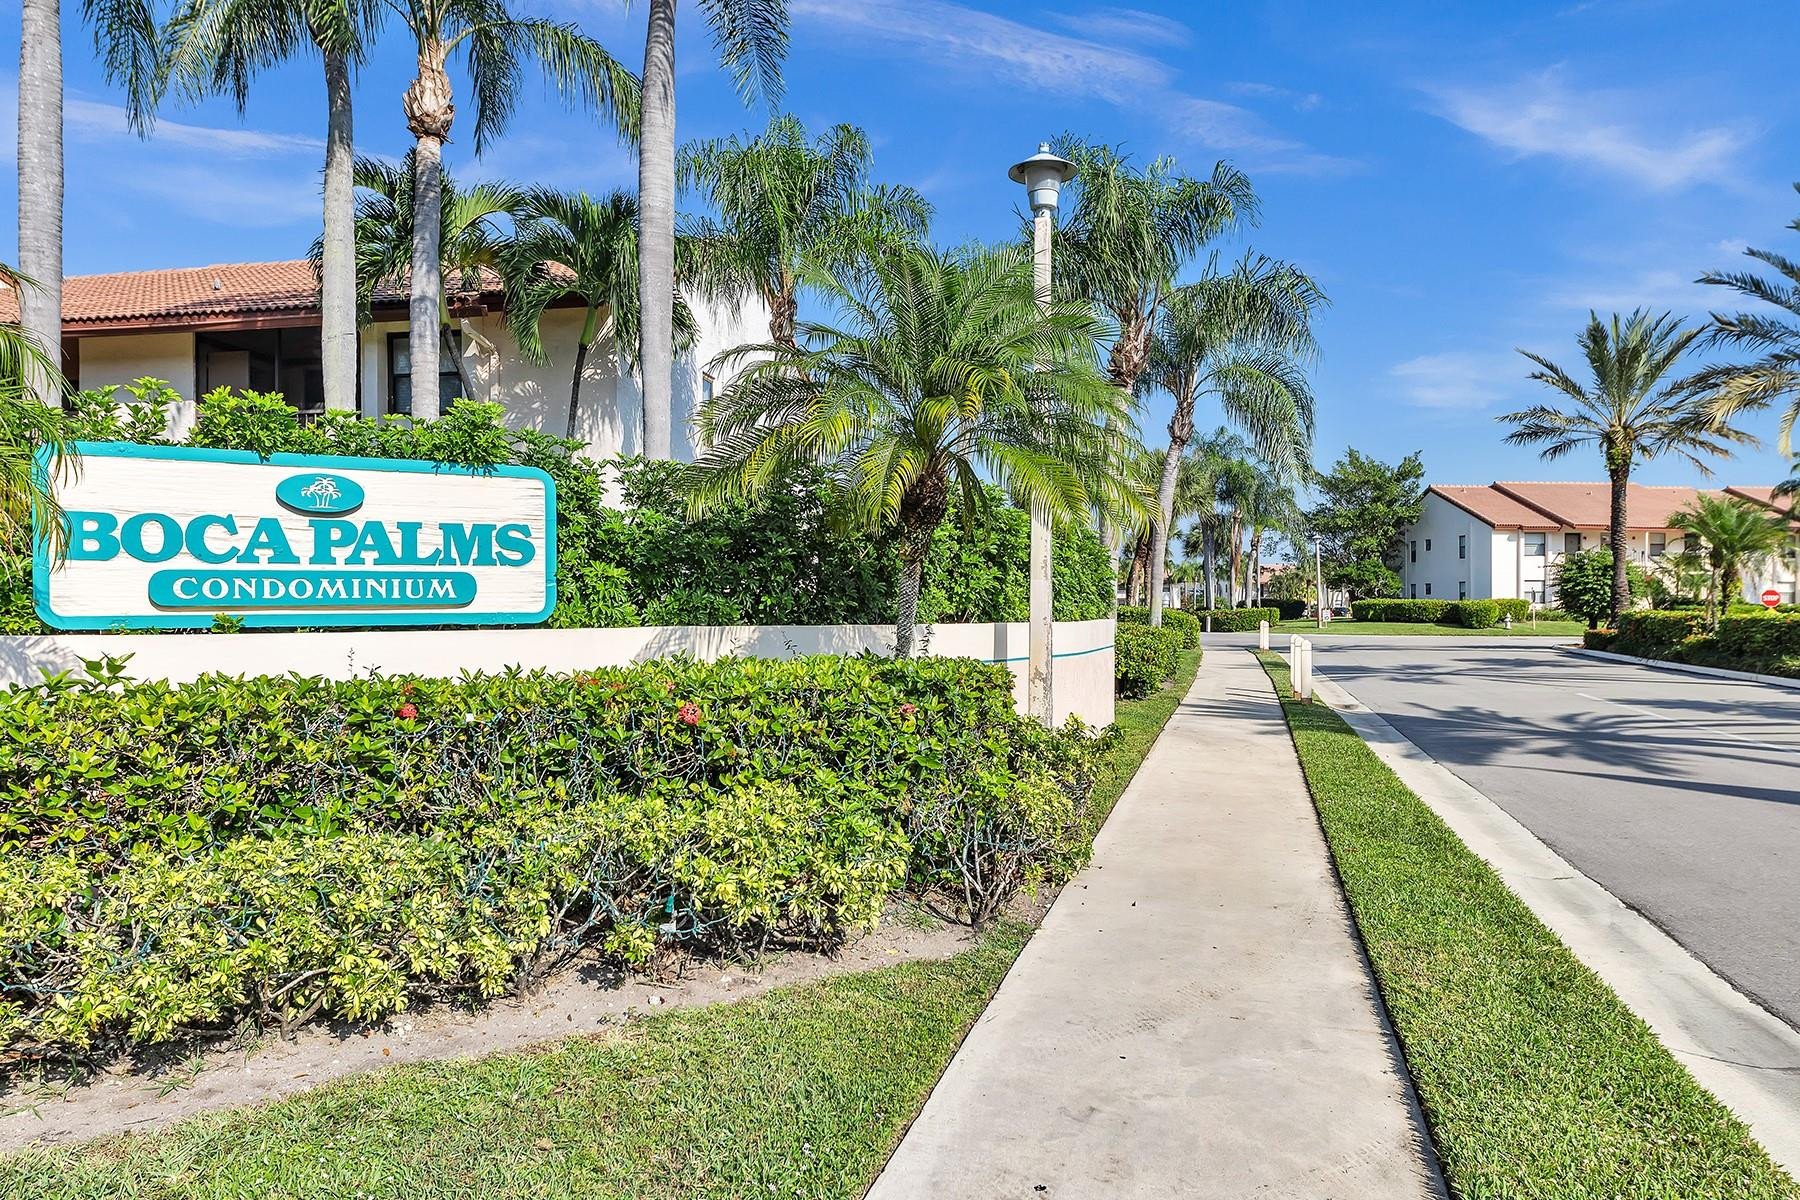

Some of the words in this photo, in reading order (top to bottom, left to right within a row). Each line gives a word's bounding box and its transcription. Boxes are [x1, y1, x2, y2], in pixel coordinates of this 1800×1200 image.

[62, 510, 301, 564] BOCA
[308, 518, 537, 567] PALMS
[172, 577, 458, 600] CONDOMINIUM
[1762, 594, 1780, 602] STOP
